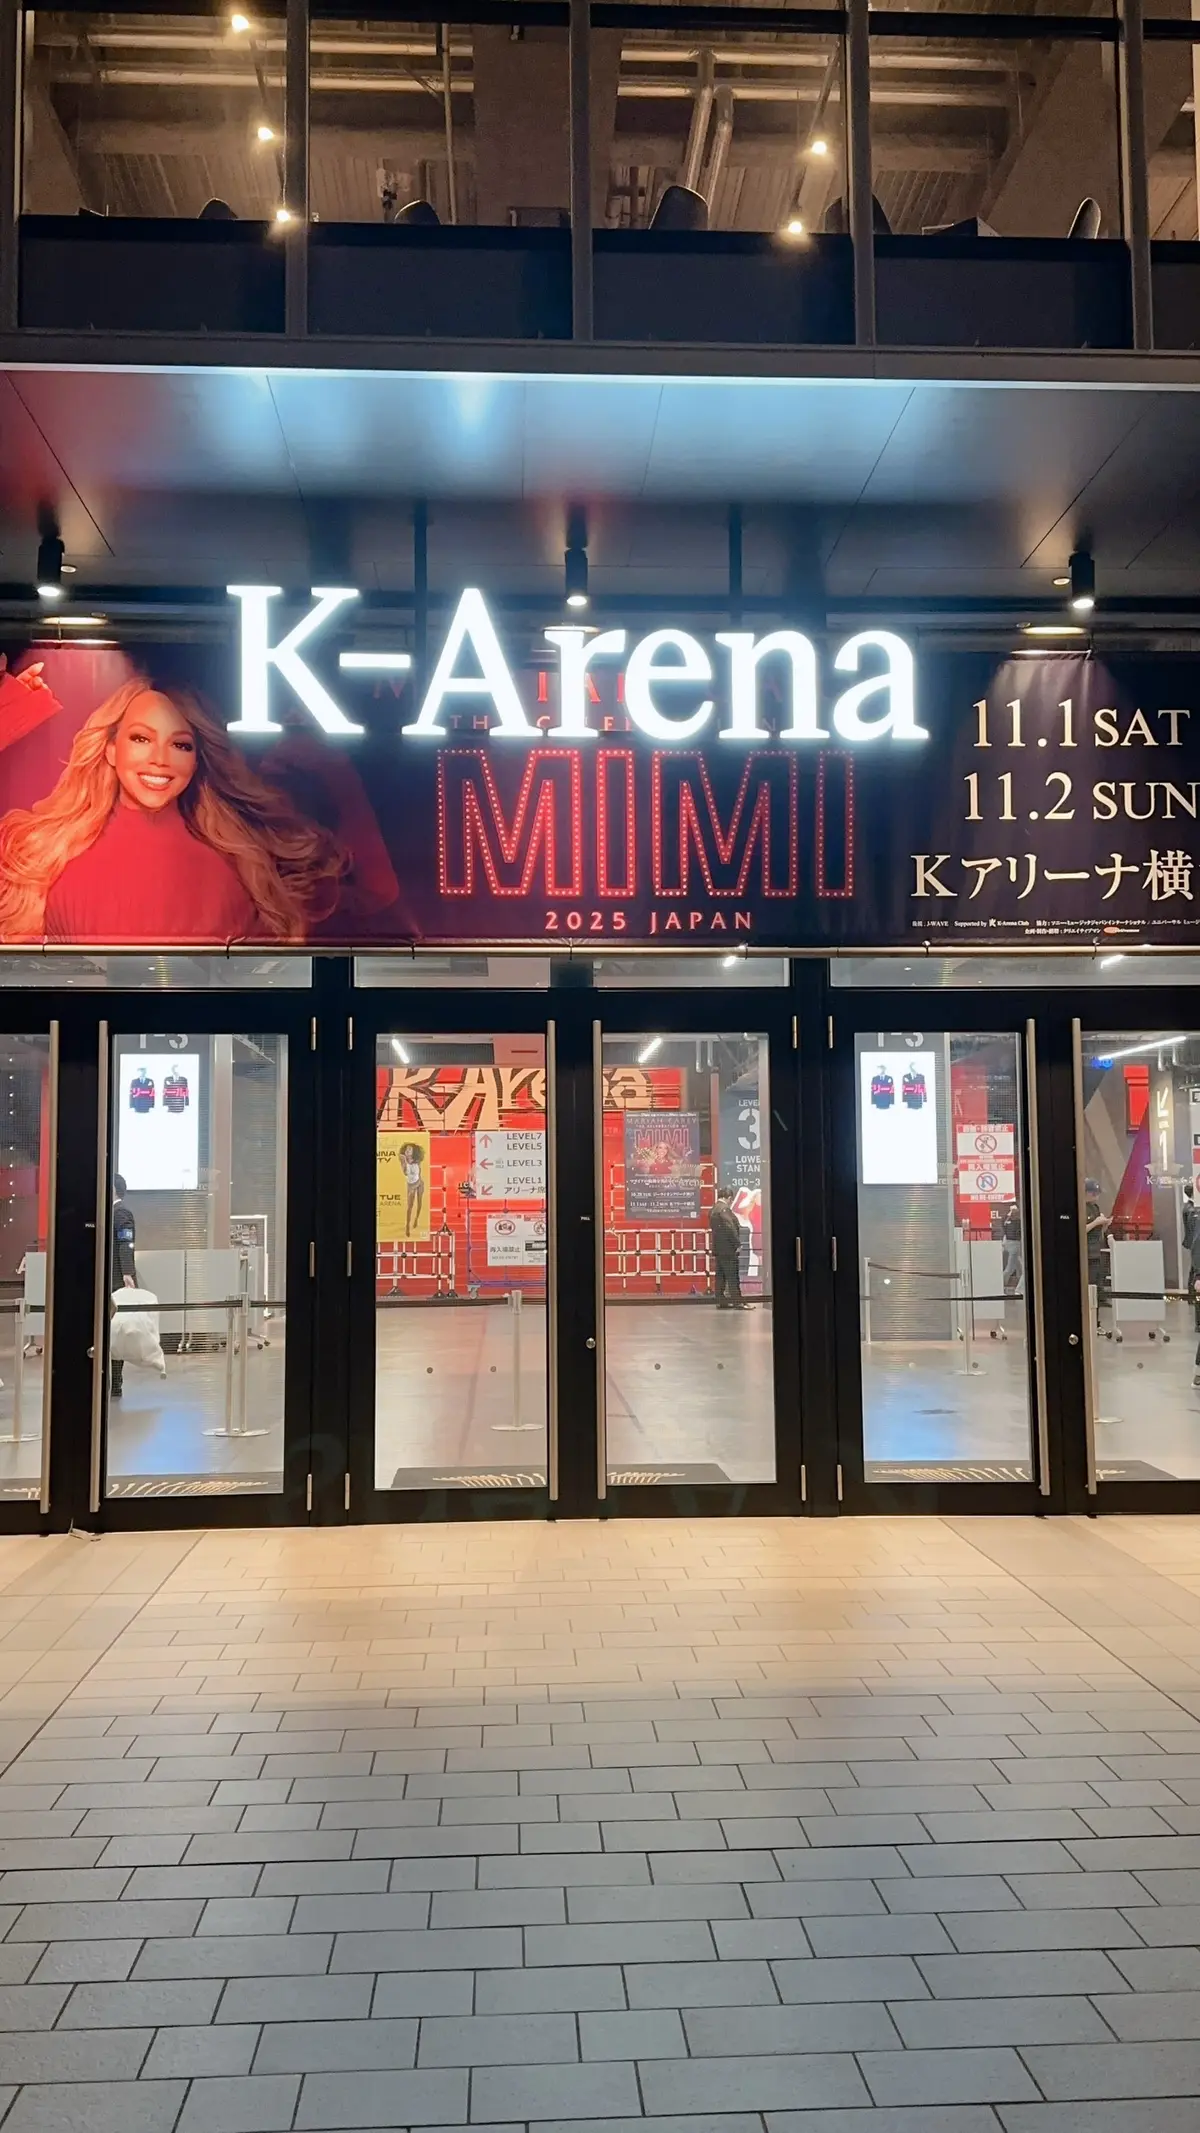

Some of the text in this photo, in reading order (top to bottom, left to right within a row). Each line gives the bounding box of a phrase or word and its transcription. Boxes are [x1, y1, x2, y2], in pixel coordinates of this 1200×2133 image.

[226, 585, 929, 741] K-Arena
[972, 698, 1191, 747] 11.1 SAT
[963, 772, 1200, 820] 11.2 SUN
[437, 747, 856, 899] MIMI
[910, 849, 1200, 901] Kアリーナ横
[545, 911, 753, 935] 2025 JAPAN
[634, 1128, 690, 1148] MIMI
[738, 1108, 761, 1150] 3
